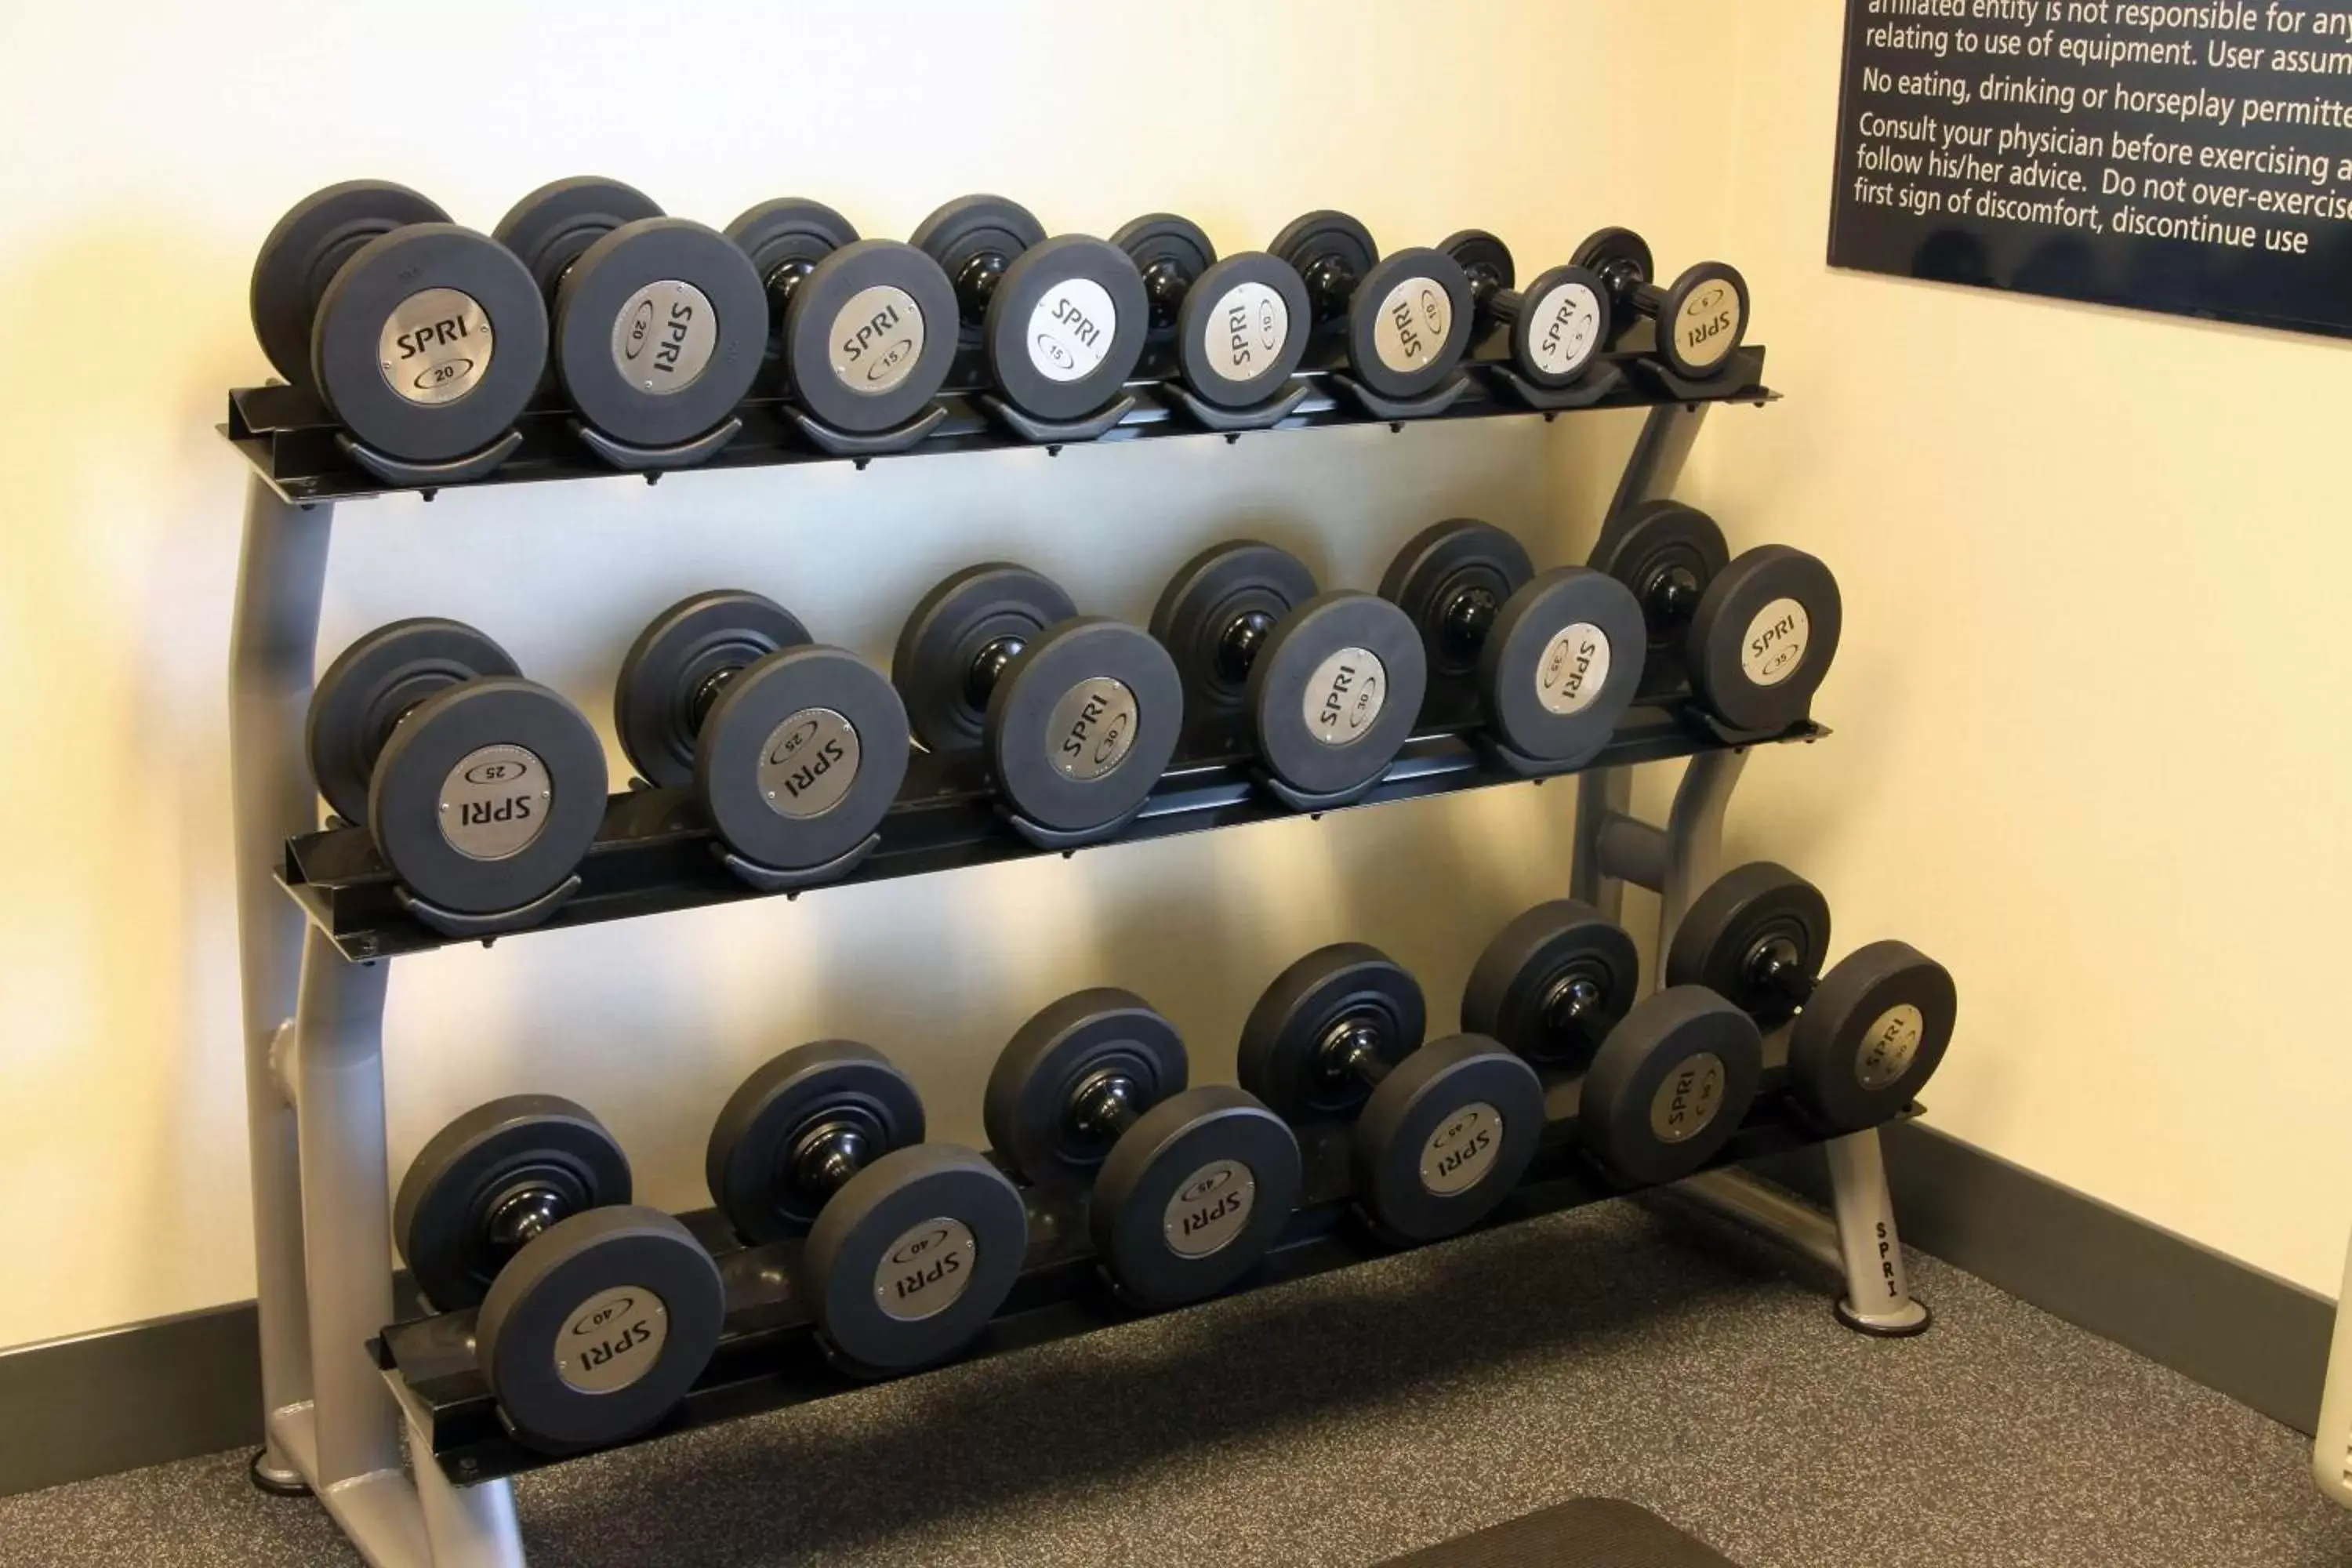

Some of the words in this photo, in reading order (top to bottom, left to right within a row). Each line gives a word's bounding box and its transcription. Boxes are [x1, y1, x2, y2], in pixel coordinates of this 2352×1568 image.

[1972, 0, 2039, 27] entity
[2045, 1, 2063, 22] is
[2067, 0, 2110, 24] not
[2114, 0, 2258, 34] responsible
[2265, 1, 2307, 34] for
[2312, 12, 2352, 43] an
[1866, 21, 1949, 58] relating
[1955, 27, 1979, 53] to
[1984, 34, 2022, 56] use
[2027, 28, 2055, 57] of
[2058, 32, 2198, 69] equipment.
[2207, 38, 2266, 70] User
[2270, 49, 2352, 75] assum
[1862, 66, 1893, 93] No
[1897, 70, 1972, 106] eating,
[1979, 72, 2076, 114] drinking
[2082, 87, 2109, 110] or
[2114, 81, 2236, 126] horseplay
[2241, 96, 2352, 129] permitte
[1856, 142, 1923, 175] follow
[1928, 150, 2005, 183] his/her
[2009, 159, 2087, 192] advice.
[2101, 167, 2136, 198] Do
[2143, 176, 2187, 203] not
[1859, 111, 1938, 143] Consult
[1940, 124, 1994, 151] your
[1998, 122, 2104, 158] physician
[2111, 130, 2194, 166] before
[2199, 143, 2330, 187] exercising
[2336, 158, 2352, 181] a
[1853, 176, 1894, 207] first
[1898, 182, 1941, 216] sign
[1947, 187, 1973, 214] of
[1975, 190, 2103, 235] discomfort,
[2111, 204, 2257, 249] discontinue
[2265, 228, 2309, 255] use
[632, 320, 647, 340] 20
[844, 305, 899, 361] SPRI
[1052, 299, 1101, 347] SPRI
[1262, 315, 1272, 332] 10
[1392, 302, 1421, 358] SPRI
[1425, 304, 1436, 319] 10
[1543, 299, 1577, 355] SPRI
[1688, 311, 1730, 347] SPRI
[397, 315, 467, 359] SPRI
[654, 303, 692, 372] SPRI
[1050, 344, 1062, 360] 15
[1229, 306, 1250, 366] SPRI
[434, 365, 454, 382] 20
[881, 352, 898, 368] 15
[1751, 615, 1794, 658] SPRI
[1562, 640, 1595, 699] SPRI
[1774, 654, 1788, 667] 35
[1320, 666, 1356, 726] SPRI
[1357, 693, 1369, 710] 30
[784, 732, 804, 753] 25
[1064, 695, 1108, 757] SPRI
[1103, 729, 1118, 747] 30
[485, 765, 506, 779] 25
[784, 739, 844, 798] SPRI
[462, 796, 531, 826] SPRI
[1867, 1018, 1904, 1068] SPRI
[1668, 1070, 1695, 1125] SPRI
[1438, 1130, 1490, 1177] SPRI
[1183, 1192, 1241, 1236] SPRI
[910, 1239, 930, 1255] 40
[1876, 1221, 1897, 1298] SPRI
[896, 1251, 960, 1298] SPRI
[592, 1308, 613, 1326] 40
[580, 1320, 651, 1371] SPRI
